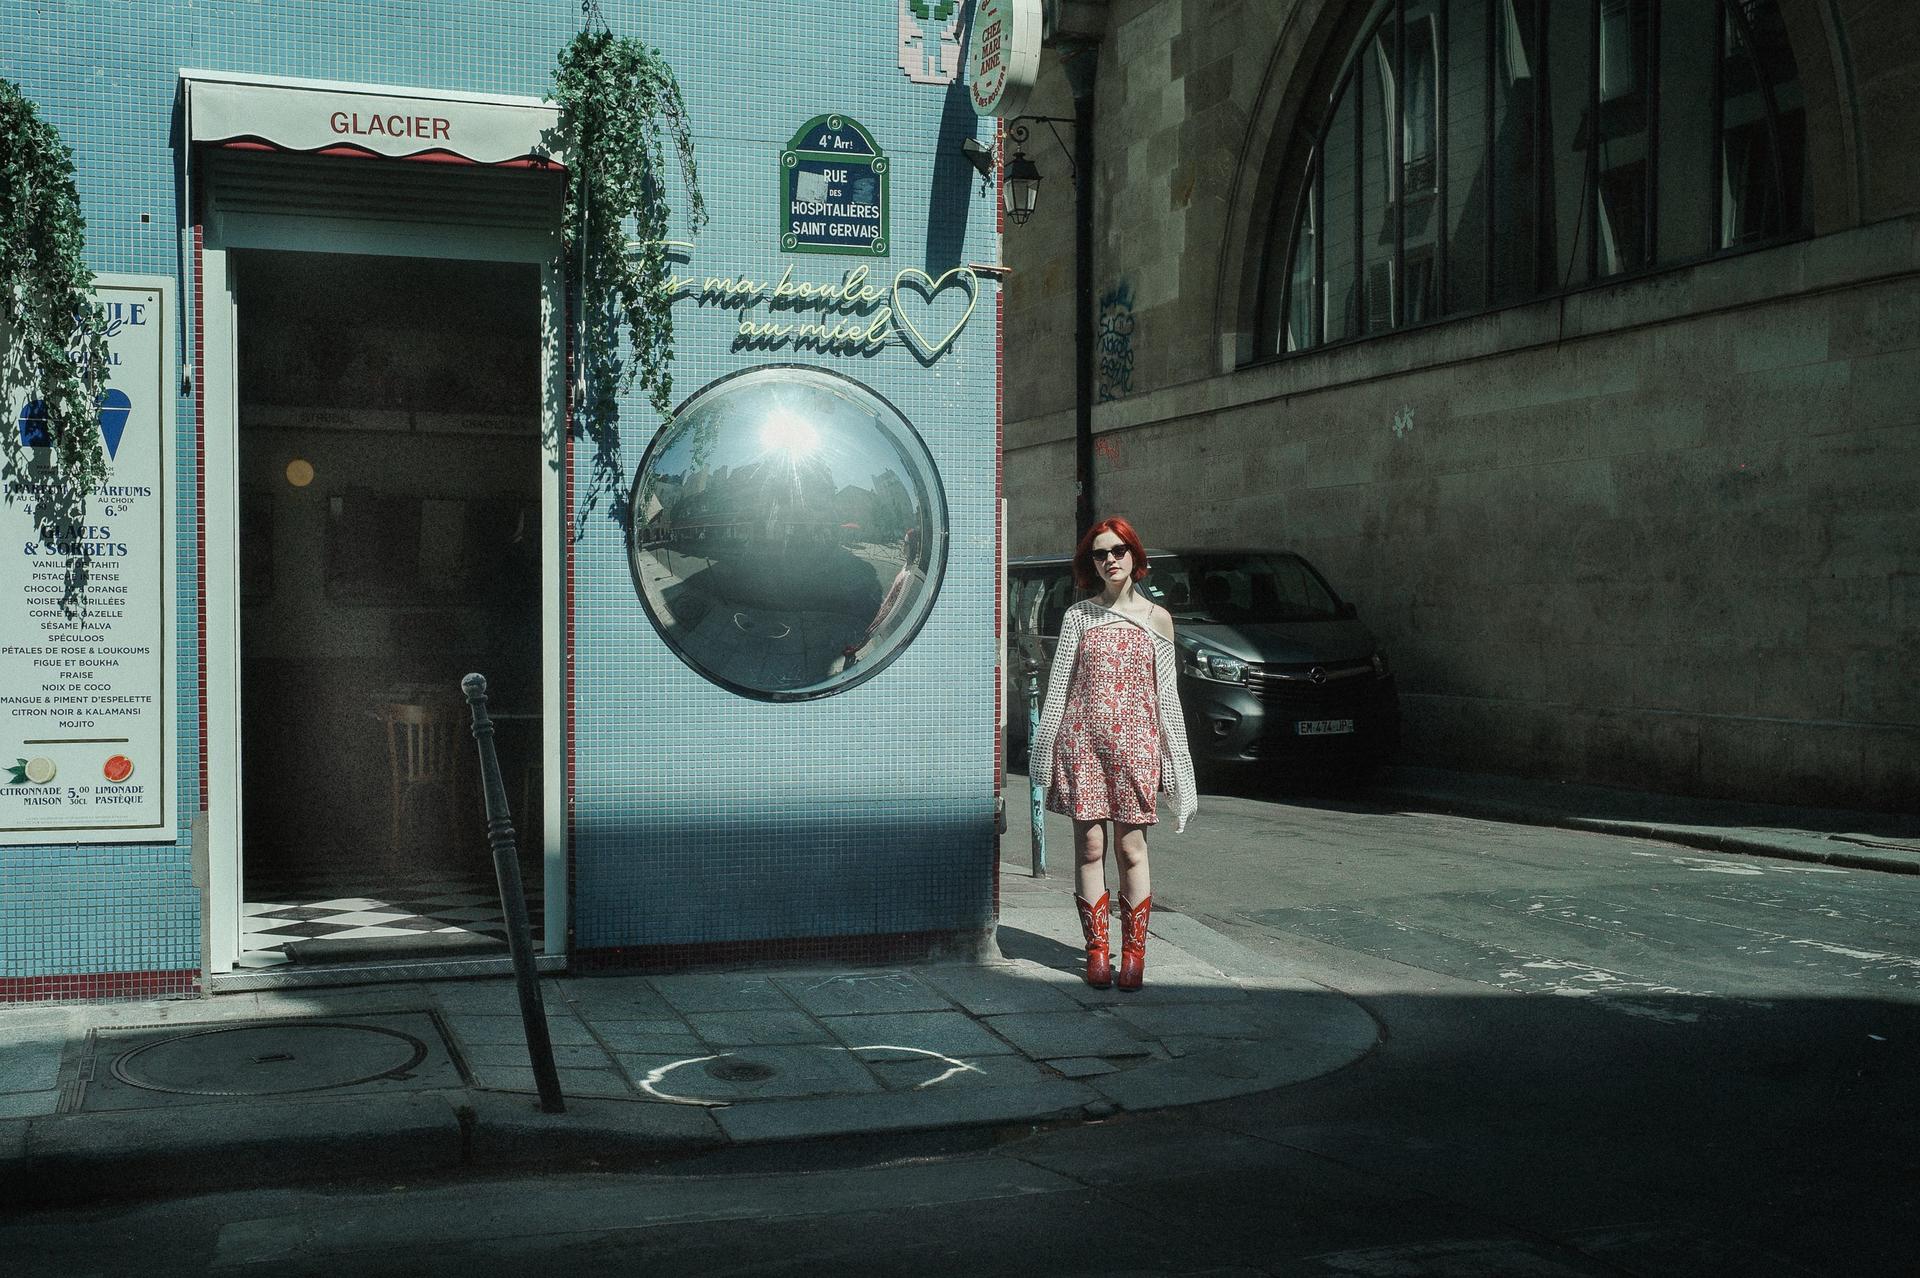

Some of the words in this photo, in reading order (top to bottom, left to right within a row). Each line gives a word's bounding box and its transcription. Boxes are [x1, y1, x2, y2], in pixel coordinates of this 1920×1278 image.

[982, 19, 1001, 42] CHEZ
[980, 51, 1001, 76] ANNE
[330, 111, 451, 141] GLACIER
[823, 169, 848, 183] RUE
[829, 189, 842, 197] DES
[791, 201, 880, 219] HOSPITALIÈRES
[792, 221, 827, 236] SAINT
[829, 223, 880, 239] GERVAIS
[703, 276, 767, 294] ma
[774, 263, 887, 301] boule
[739, 319, 794, 336] au
[799, 306, 893, 343] miel
[4, 484, 9, 494] 1
[93, 486, 151, 497] PARFUMS
[41, 526, 111, 540] GLACES
[23, 541, 38, 556] &
[45, 541, 128, 557] SORBETS
[32, 561, 73, 569] VANILLE
[75, 561, 88, 569] DE
[90, 561, 120, 569] TAHITI
[33, 573, 77, 581] PISTACHE
[81, 597, 126, 606] GRILLÉES
[29, 610, 62, 618] CORNE
[65, 610, 78, 618] DE
[81, 610, 123, 618] GAZELLE
[40, 621, 78, 630] SÉSAME
[48, 633, 105, 642] SPÉCULOOS
[1, 646, 43, 655] PÉTALES
[45, 647, 58, 655] DE
[61, 647, 86, 655] ROSE
[88, 647, 95, 655] &
[97, 647, 150, 655] LOUKOUMS
[53, 696, 89, 704] PIMENT
[91, 695, 152, 704] D'ESPELETTE
[85, 708, 142, 716] KALAMANSI
[59, 720, 95, 728] MOJITO
[0, 787, 62, 796] CITRONNADE
[95, 785, 144, 795] LIMONADE
[23, 797, 62, 806] MAISON
[95, 794, 144, 804] PASTÈQUE
